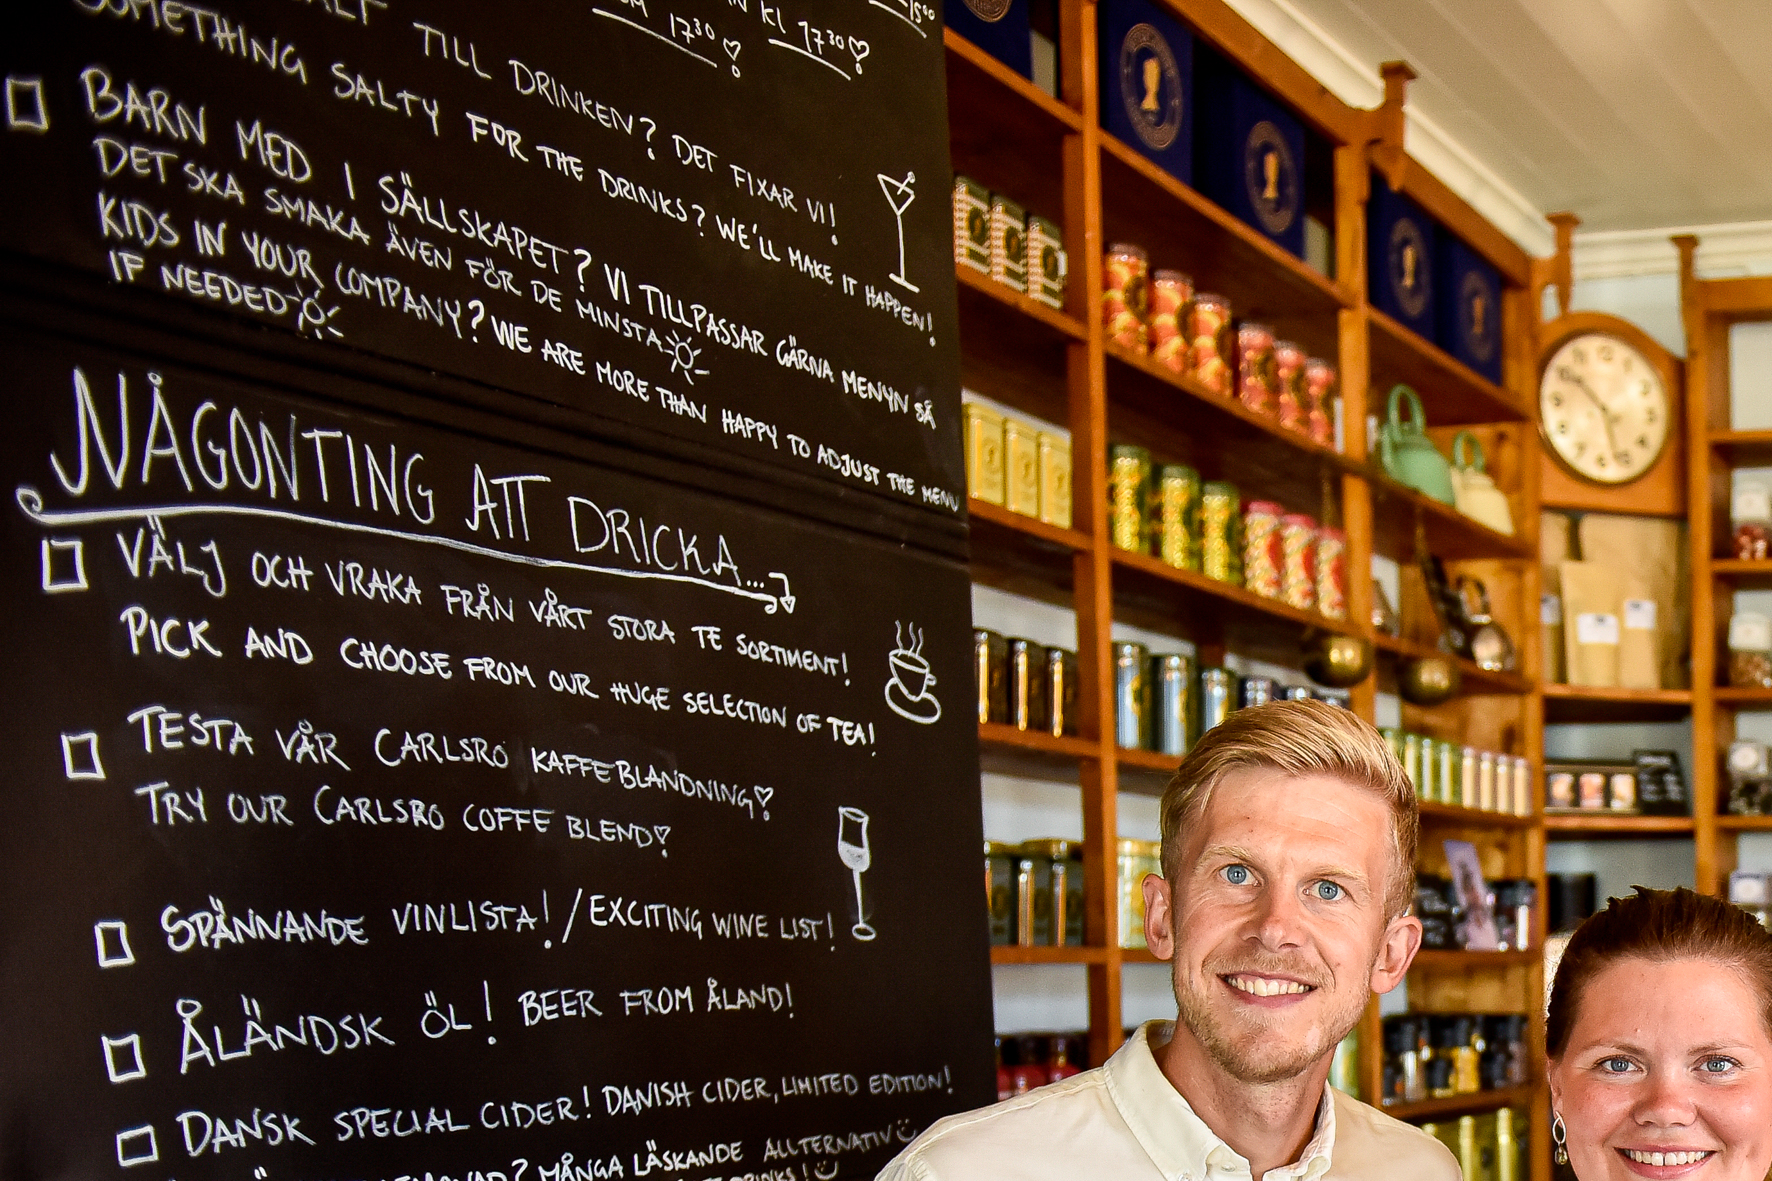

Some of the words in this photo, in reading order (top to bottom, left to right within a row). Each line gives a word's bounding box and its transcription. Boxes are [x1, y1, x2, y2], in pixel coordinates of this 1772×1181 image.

[74, 0, 308, 84] METHING
[331, 63, 438, 136] SALTY
[466, 112, 529, 162] FOR
[536, 146, 583, 181] THE
[598, 169, 705, 236] DRINKS?
[716, 215, 781, 262] WE'LL
[788, 247, 833, 285] MAKE
[843, 274, 857, 295] IT
[865, 285, 936, 347] HAPPEN!
[413, 23, 492, 79] TILL
[509, 60, 656, 160] DRINKEN?
[672, 135, 717, 172] DET
[730, 164, 797, 212] FIXAR
[807, 198, 838, 245] VI!
[80, 67, 207, 145] BARN
[237, 120, 312, 183] MED
[344, 163, 355, 200] I
[379, 171, 591, 292] SÄLLSKAPET?
[604, 264, 630, 304] VI
[639, 285, 767, 356] TILLPASSAR
[776, 335, 834, 383] GÄRNA
[842, 370, 908, 413] MENYN
[914, 400, 936, 429] SÅ
[93, 136, 178, 183] DET
[183, 163, 245, 205] SKA
[264, 189, 370, 245] SMAKA
[386, 221, 451, 270] ÄVEN
[465, 257, 521, 296] FÖR
[531, 280, 561, 312] DE
[576, 299, 663, 352] MINSTA
[109, 250, 144, 281] IF
[161, 264, 288, 314] NEEDED
[98, 192, 180, 247] KIDS
[194, 221, 226, 256] IN
[242, 232, 324, 289] YOUR
[335, 263, 484, 343] COMPANY?
[491, 316, 532, 353] WE
[541, 339, 585, 375] ARE
[596, 361, 649, 402] MORE
[655, 387, 706, 423] THAN
[722, 409, 778, 449] HAPPY
[787, 434, 810, 458] TO
[817, 444, 880, 485] ADJUST
[887, 473, 915, 495] THE
[922, 486, 958, 512] MENU
[50, 368, 435, 524] NÅGONTING
[465, 464, 551, 541] ATT
[116, 515, 226, 597] VÄLJ
[252, 551, 313, 591] OCH
[325, 561, 421, 604] VRAKA
[440, 583, 514, 622] FRÅN
[529, 588, 592, 629] VÅRT
[608, 614, 675, 644] STORA
[691, 626, 722, 650] TE
[736, 634, 850, 686] SORTIMENT!
[120, 606, 222, 658] PICK
[245, 627, 313, 664] AND
[340, 638, 452, 679] CHOOSE
[463, 657, 536, 688] FROM
[549, 670, 599, 698] OUR
[610, 682, 670, 711] HUGE
[683, 692, 786, 727] SELECTION
[797, 714, 821, 733] OF
[826, 717, 876, 756] TEA!
[127, 706, 253, 755] TESTA
[275, 720, 351, 770] VÅR
[135, 781, 207, 825] TRY
[227, 793, 293, 825] OUR
[463, 804, 554, 832] COFFE
[160, 895, 368, 952] SPÄNNANDE
[712, 913, 768, 939] WINE
[780, 912, 835, 951] LIST!
[176, 995, 395, 1074] ÅLÄNDSK
[518, 989, 602, 1026] BEER
[619, 986, 693, 1015] FROM
[707, 977, 793, 1018] ÅLAND!
[176, 1108, 316, 1156] DANSK
[334, 1107, 470, 1141] SPECIAL
[480, 1086, 591, 1129] CIDER!
[602, 1081, 693, 1115] DANISH
[703, 1078, 778, 1103] CIDER,
[782, 1074, 858, 1096] LIMITED
[869, 1066, 953, 1094] EDITION!
[634, 1139, 743, 1176] LÄSKANDE
